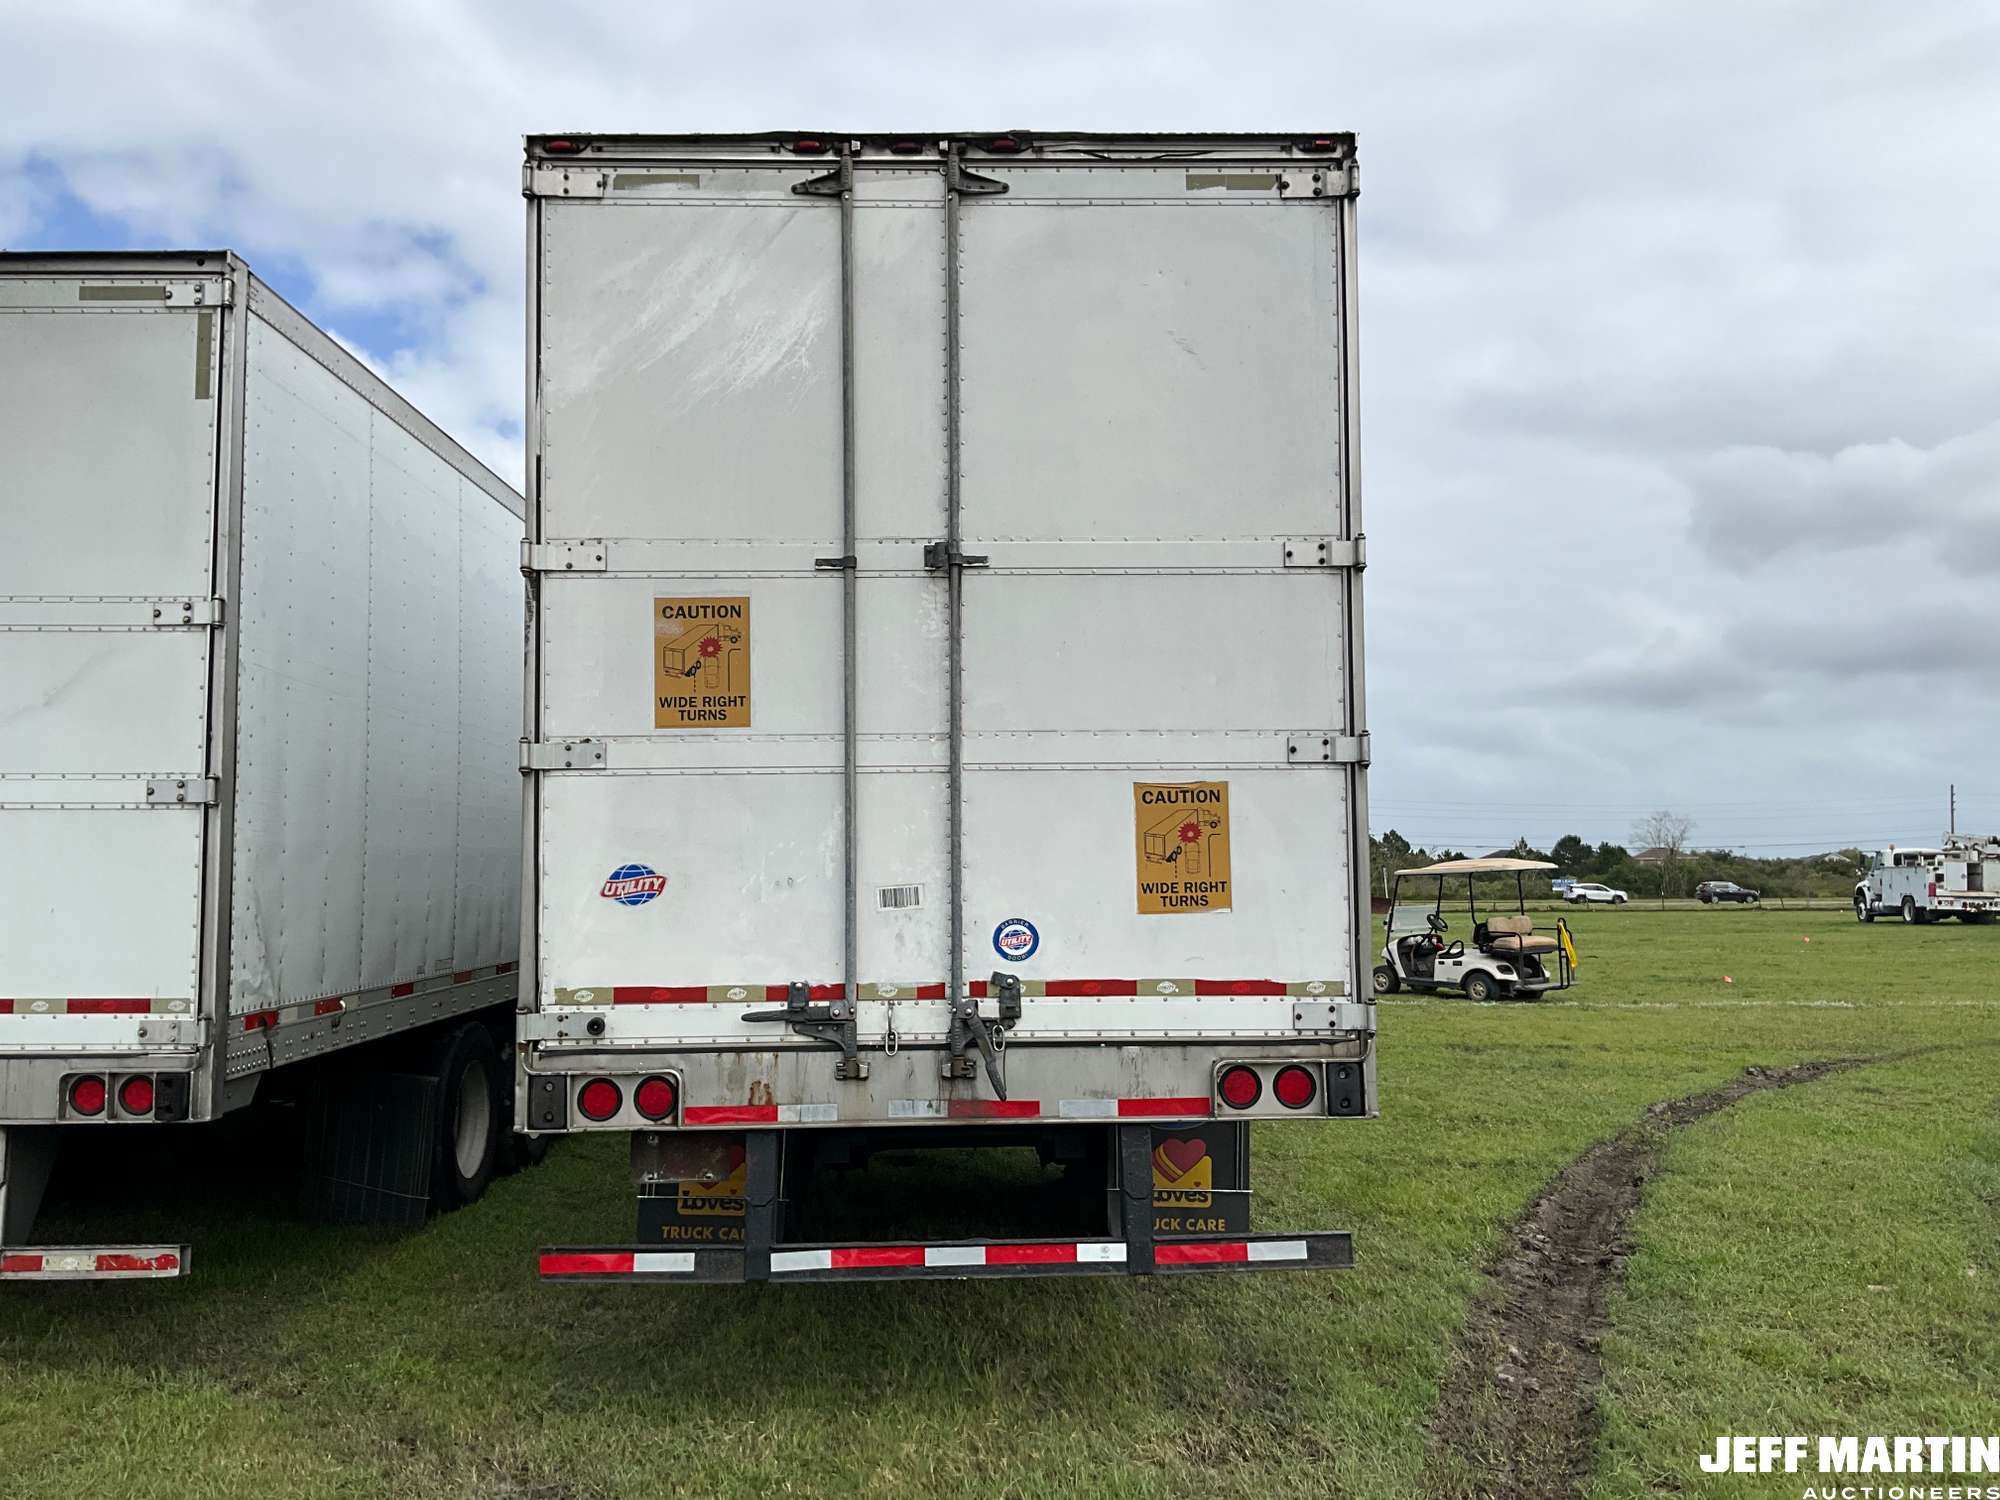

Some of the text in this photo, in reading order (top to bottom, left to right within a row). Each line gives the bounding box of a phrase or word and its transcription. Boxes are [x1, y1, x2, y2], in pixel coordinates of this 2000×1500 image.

[661, 605, 741, 619] CAUTION
[659, 695, 746, 708] WIDE RIGHT
[678, 709, 727, 721] TURNS
[1141, 789, 1221, 804] CAUTION
[604, 878, 663, 896] UTILITY
[1141, 881, 1227, 894] WIDE RIGHT
[1160, 895, 1209, 907] TURNS
[1001, 935, 1031, 946] UTILITY
[1186, 1218, 1226, 1231] CARE
[661, 1226, 745, 1240] TRUCK CA
